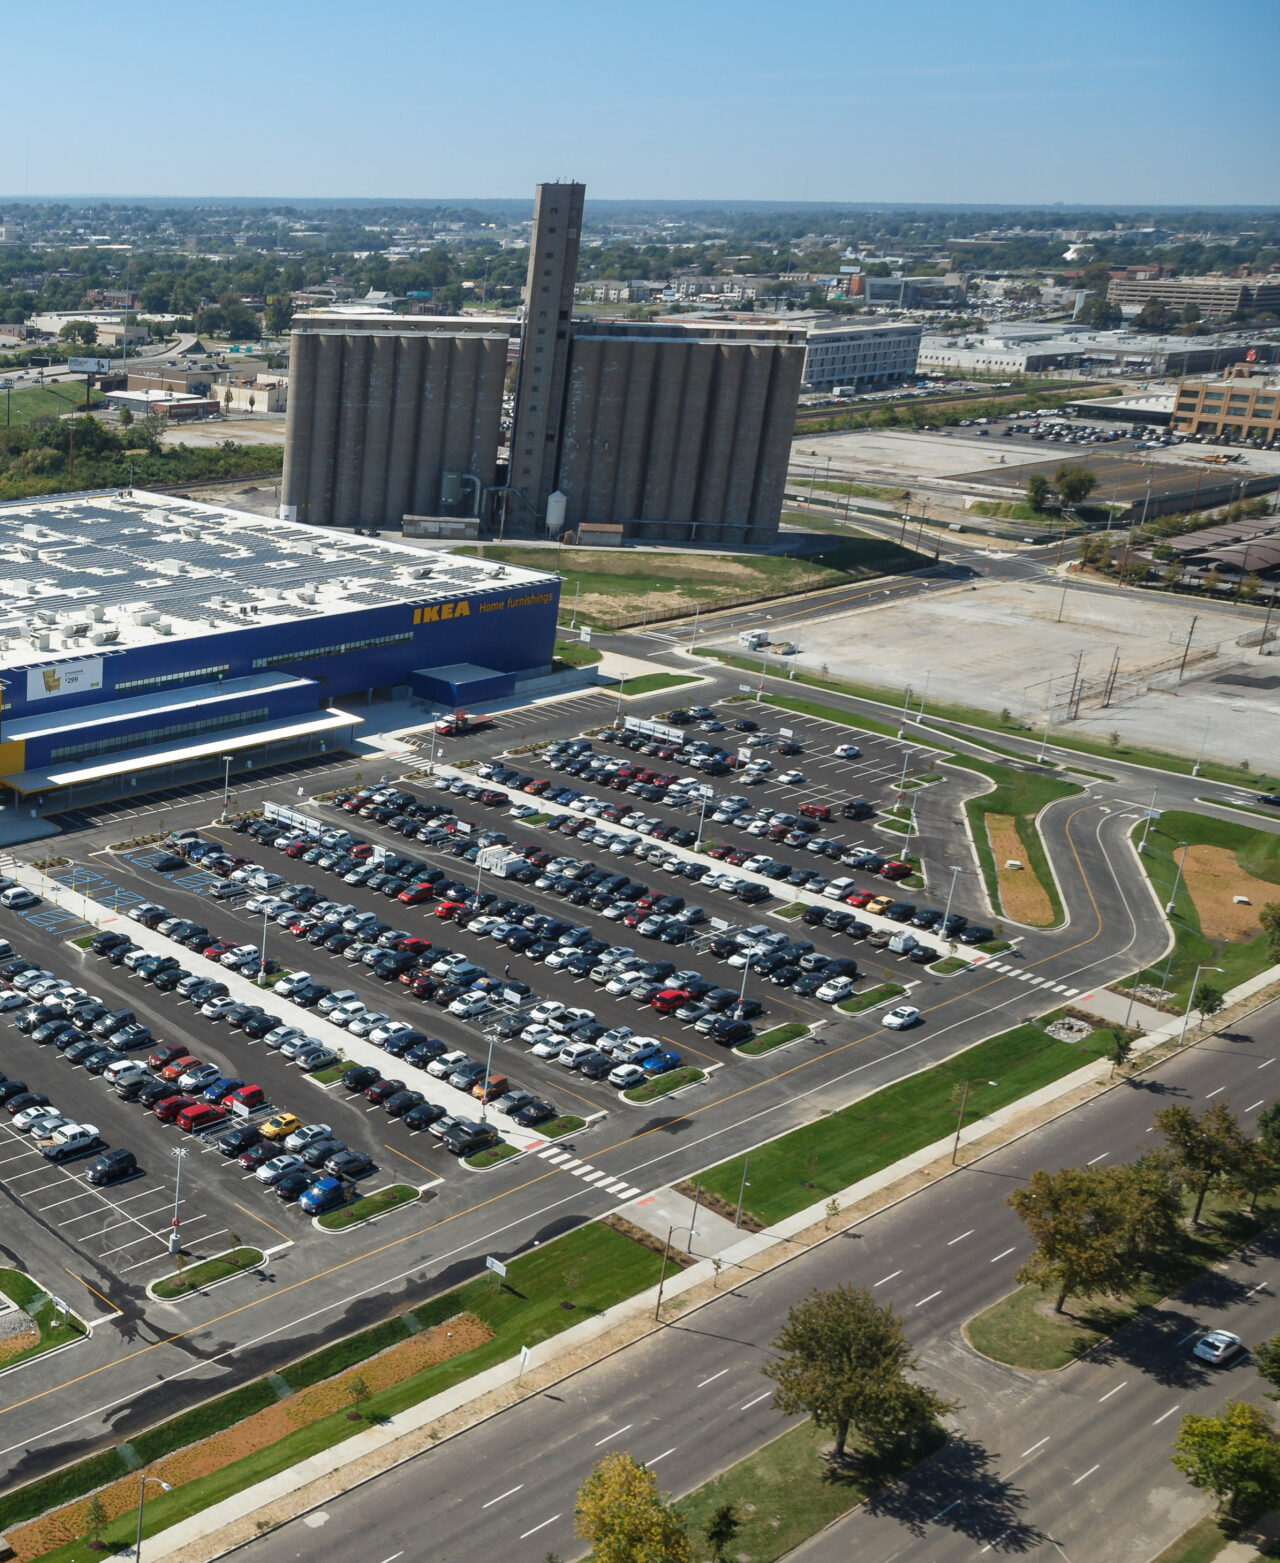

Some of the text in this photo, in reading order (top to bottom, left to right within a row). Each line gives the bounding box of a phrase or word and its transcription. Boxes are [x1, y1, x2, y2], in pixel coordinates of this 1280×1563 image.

[413, 593, 553, 625] IKEA Home furnishings
